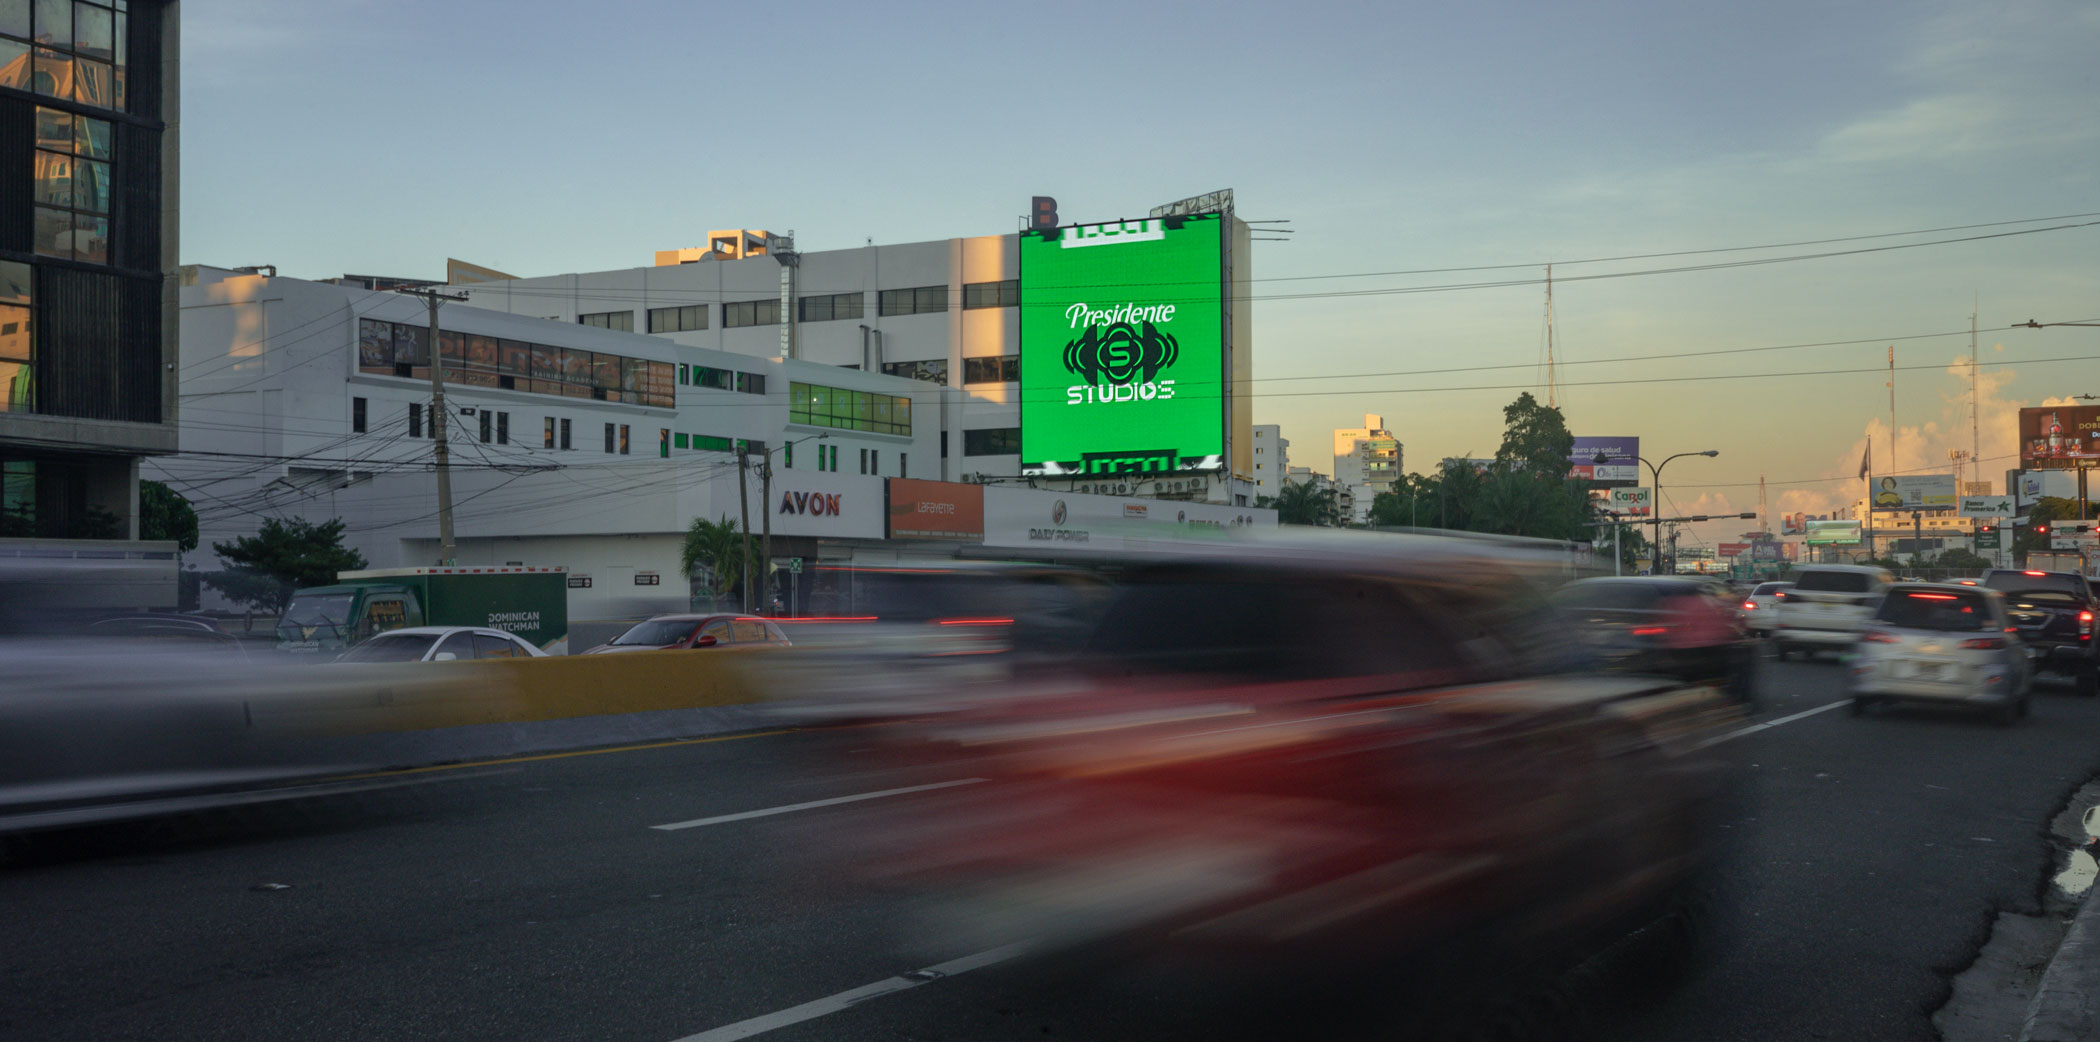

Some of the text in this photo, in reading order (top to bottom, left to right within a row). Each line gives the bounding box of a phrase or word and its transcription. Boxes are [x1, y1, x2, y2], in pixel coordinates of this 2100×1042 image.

[1065, 302, 1176, 328] Presidente
[1067, 379, 1176, 405] STUDIOS
[1600, 446, 1622, 454] salud
[779, 490, 842, 517] AVON
[488, 610, 540, 622] DOMINICAN
[488, 621, 540, 632] WATCHMAN
